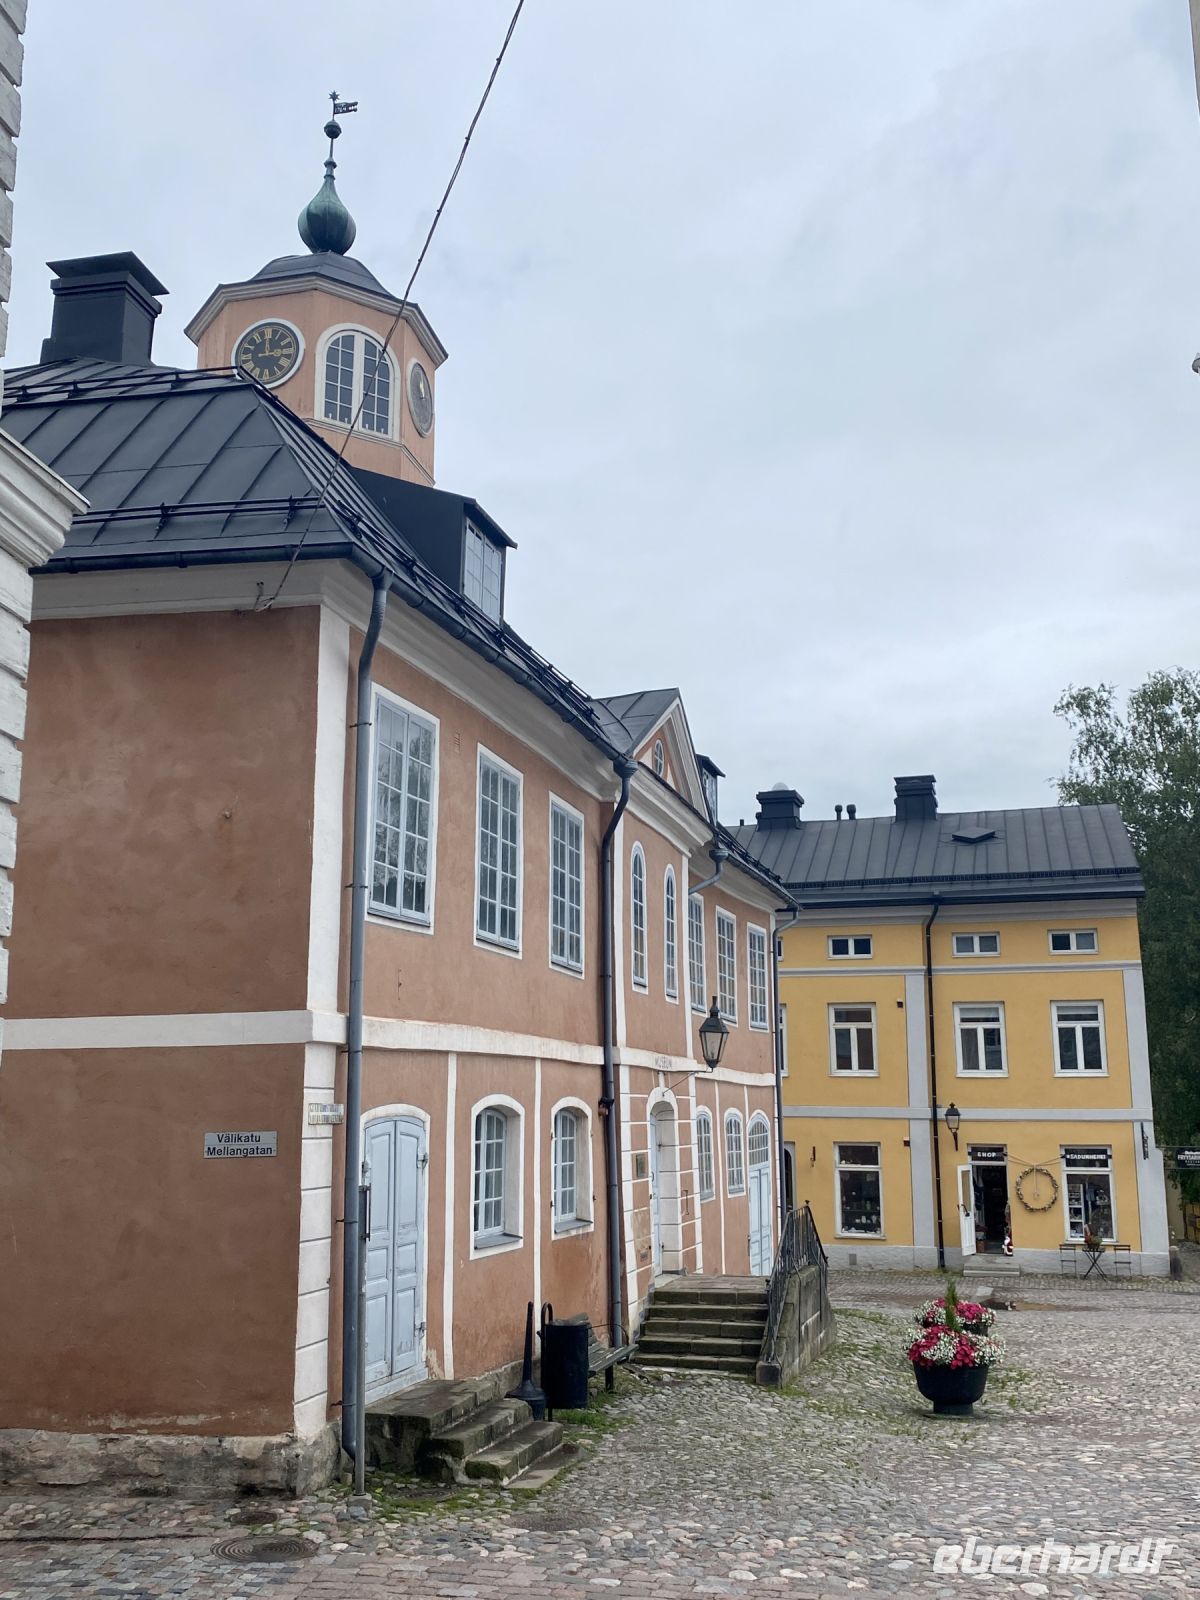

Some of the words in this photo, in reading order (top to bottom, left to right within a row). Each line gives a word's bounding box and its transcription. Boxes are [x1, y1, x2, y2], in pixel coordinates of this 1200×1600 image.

[216, 1133, 261, 1143] Välikatu
[207, 1145, 273, 1158] Mellangatan
[977, 1151, 997, 1159] SHOP
